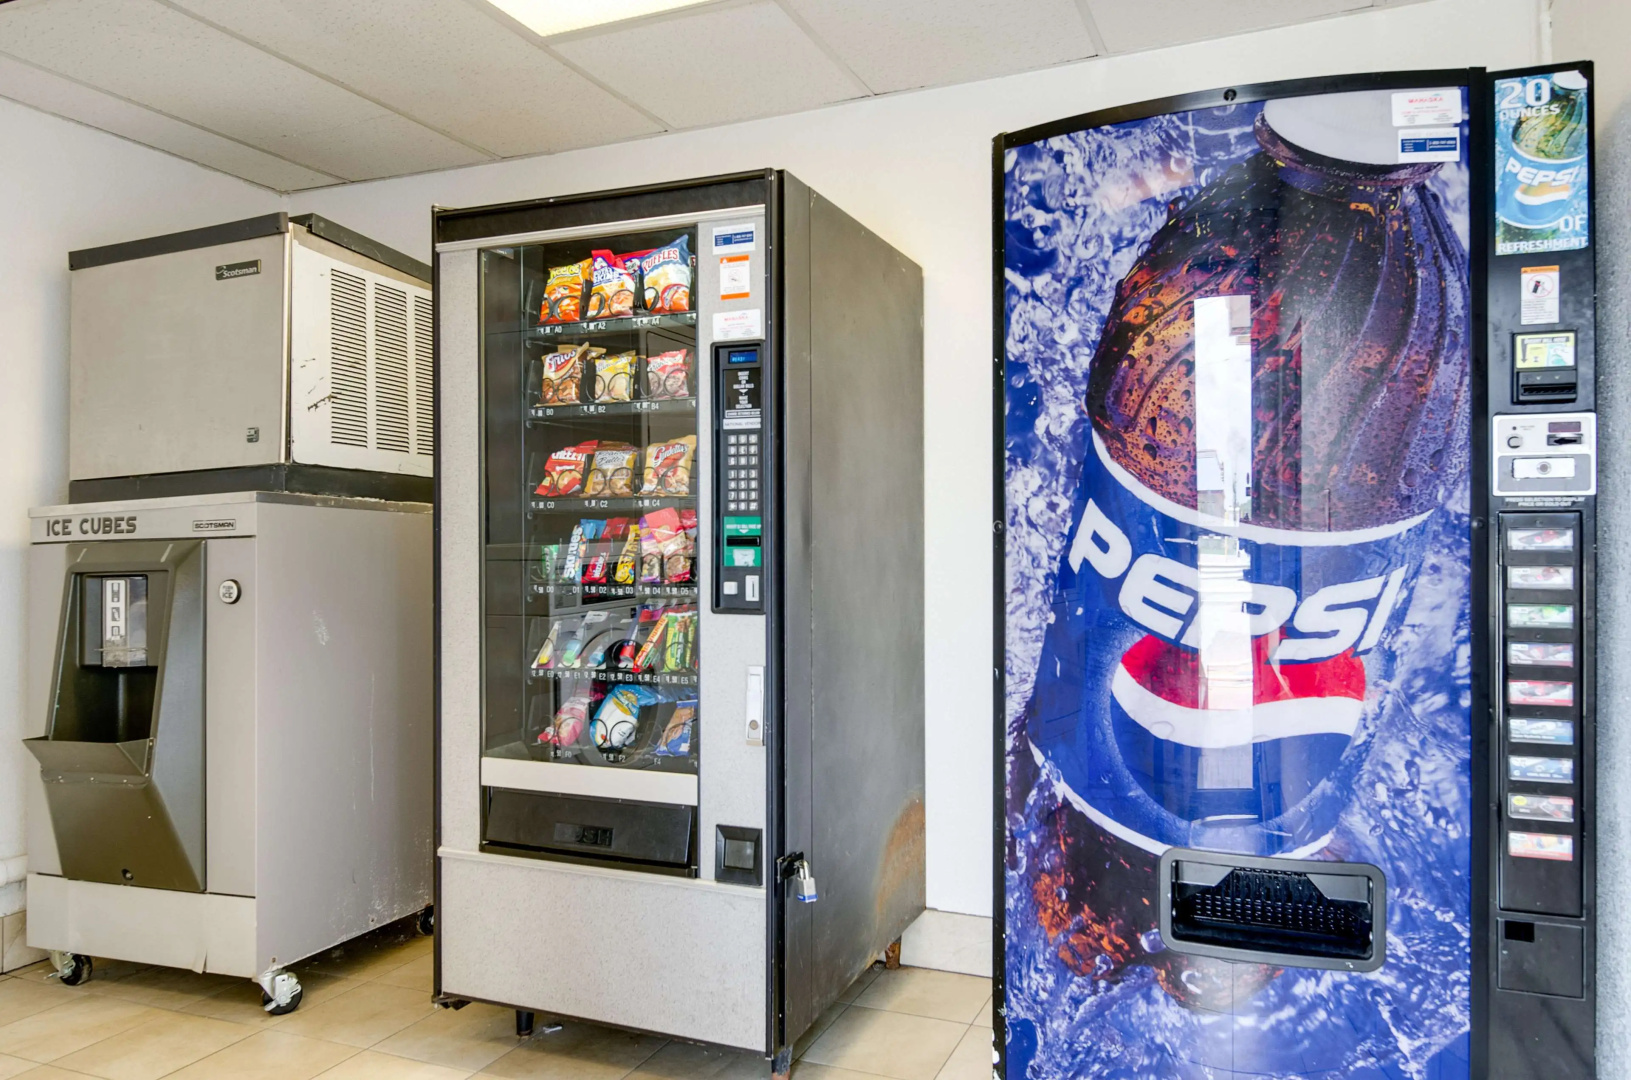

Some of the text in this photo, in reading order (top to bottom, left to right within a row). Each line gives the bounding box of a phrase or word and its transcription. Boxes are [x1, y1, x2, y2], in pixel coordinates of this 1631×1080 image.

[1500, 78, 1551, 109] 20
[1500, 104, 1561, 122] OUNCES
[1505, 157, 1579, 186] PEPSI
[1560, 215, 1586, 232] OF
[1498, 237, 1587, 253] REFRESHMENT
[641, 248, 679, 272] RUFFLES
[222, 265, 257, 278] Scotsman
[597, 322, 606, 330] A2
[651, 317, 660, 326] A4
[545, 348, 577, 372] Fritos
[597, 405, 606, 413] B2
[651, 402, 659, 410] B4
[600, 500, 608, 508] C2
[652, 499, 660, 507] C4
[46, 516, 137, 537] ICE CUBES
[194, 520, 234, 530] SCOTSMAN
[1068, 498, 1407, 661] PEPSI
[681, 676, 689, 684] E5
[618, 755, 626, 763] F2
